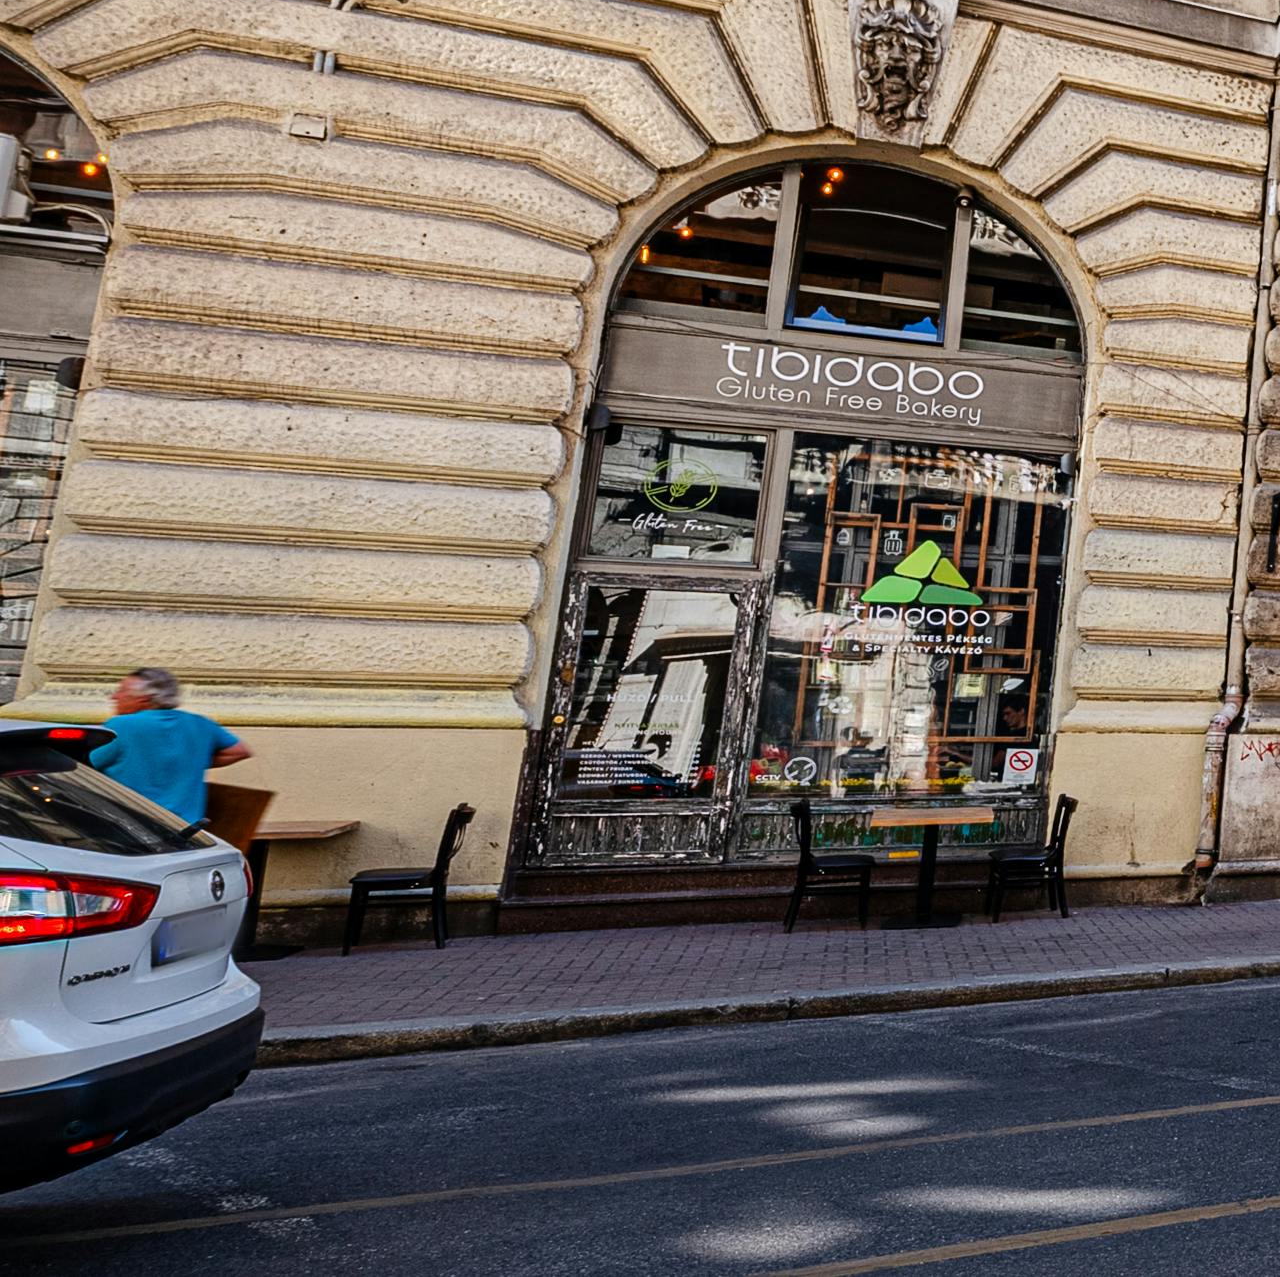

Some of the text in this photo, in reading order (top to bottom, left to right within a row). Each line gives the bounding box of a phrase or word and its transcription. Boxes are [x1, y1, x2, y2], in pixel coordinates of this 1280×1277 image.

[721, 342, 984, 400] tibidabo
[716, 377, 981, 426] Gluten Free Bakery
[632, 512, 714, 533] Gluten Free
[850, 604, 991, 627] tibidabo
[852, 644, 860, 652] &
